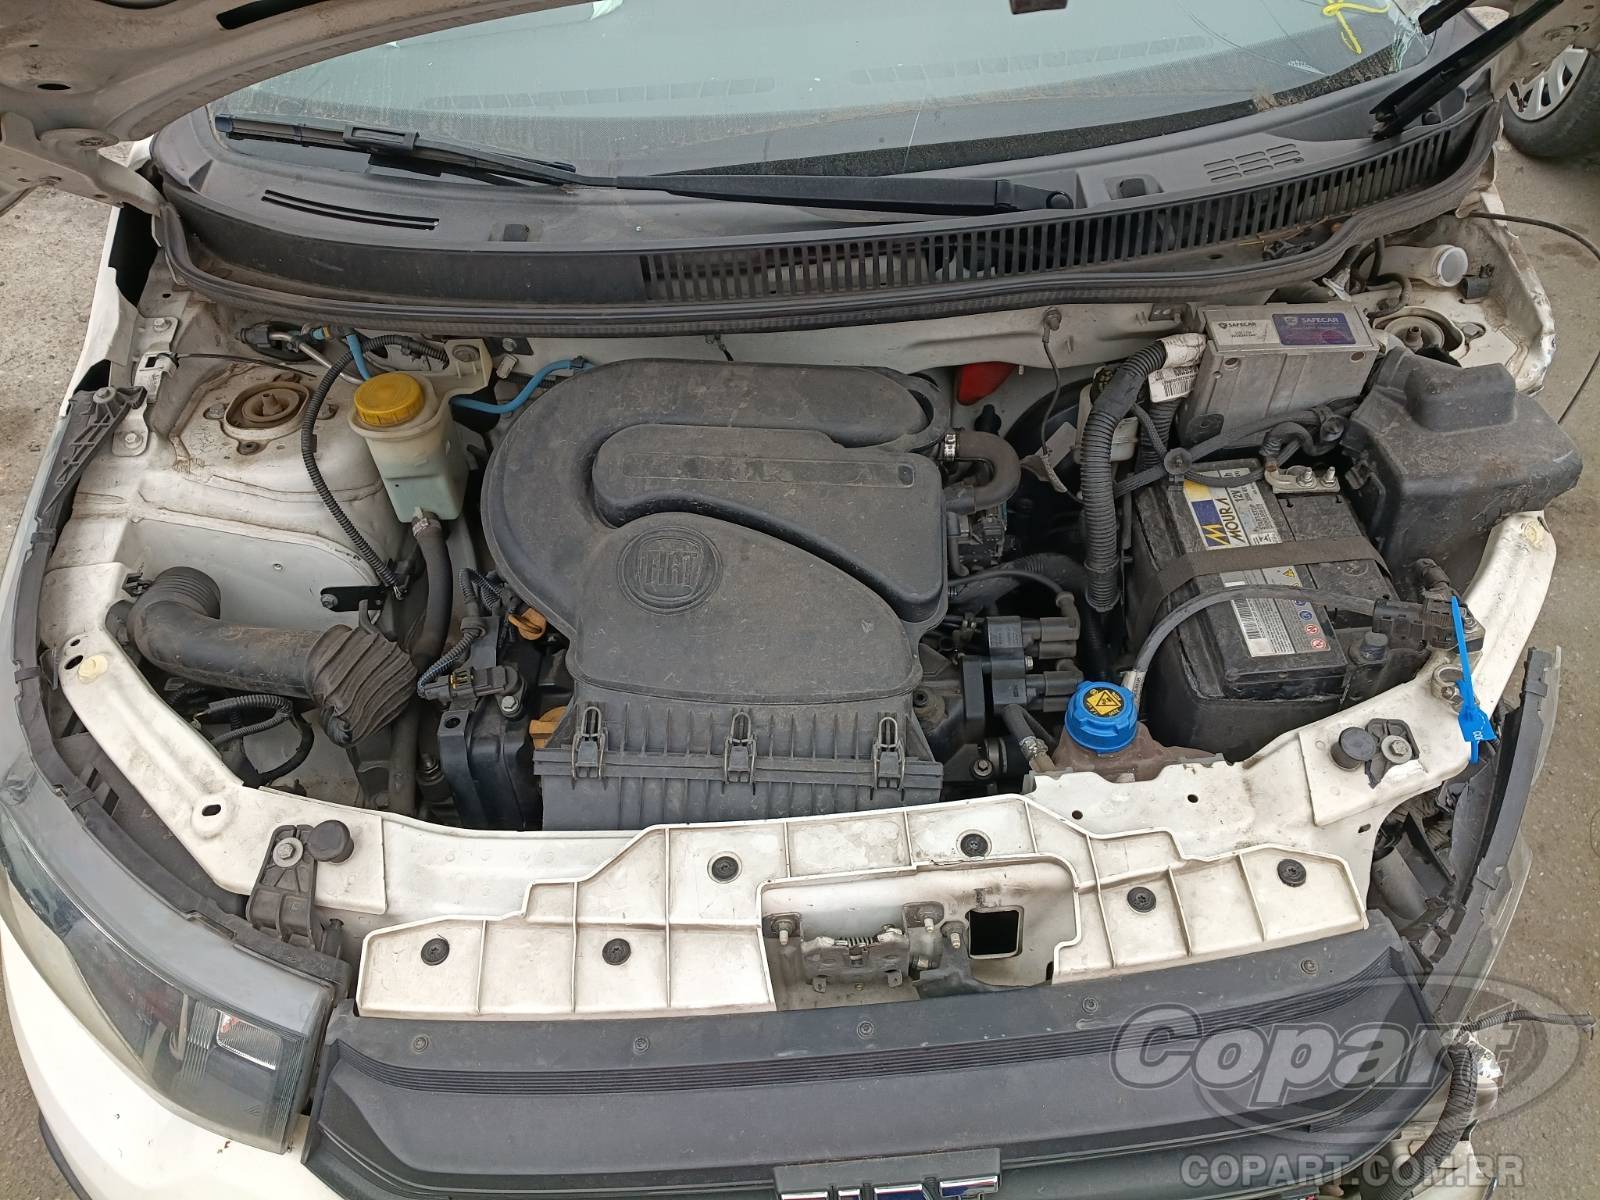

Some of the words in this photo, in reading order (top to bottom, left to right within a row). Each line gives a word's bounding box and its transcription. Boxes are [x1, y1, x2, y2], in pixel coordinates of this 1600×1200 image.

[1231, 489, 1246, 502] 12V
[1215, 498, 1245, 543] MOURA
[645, 550, 699, 586] FIAT
